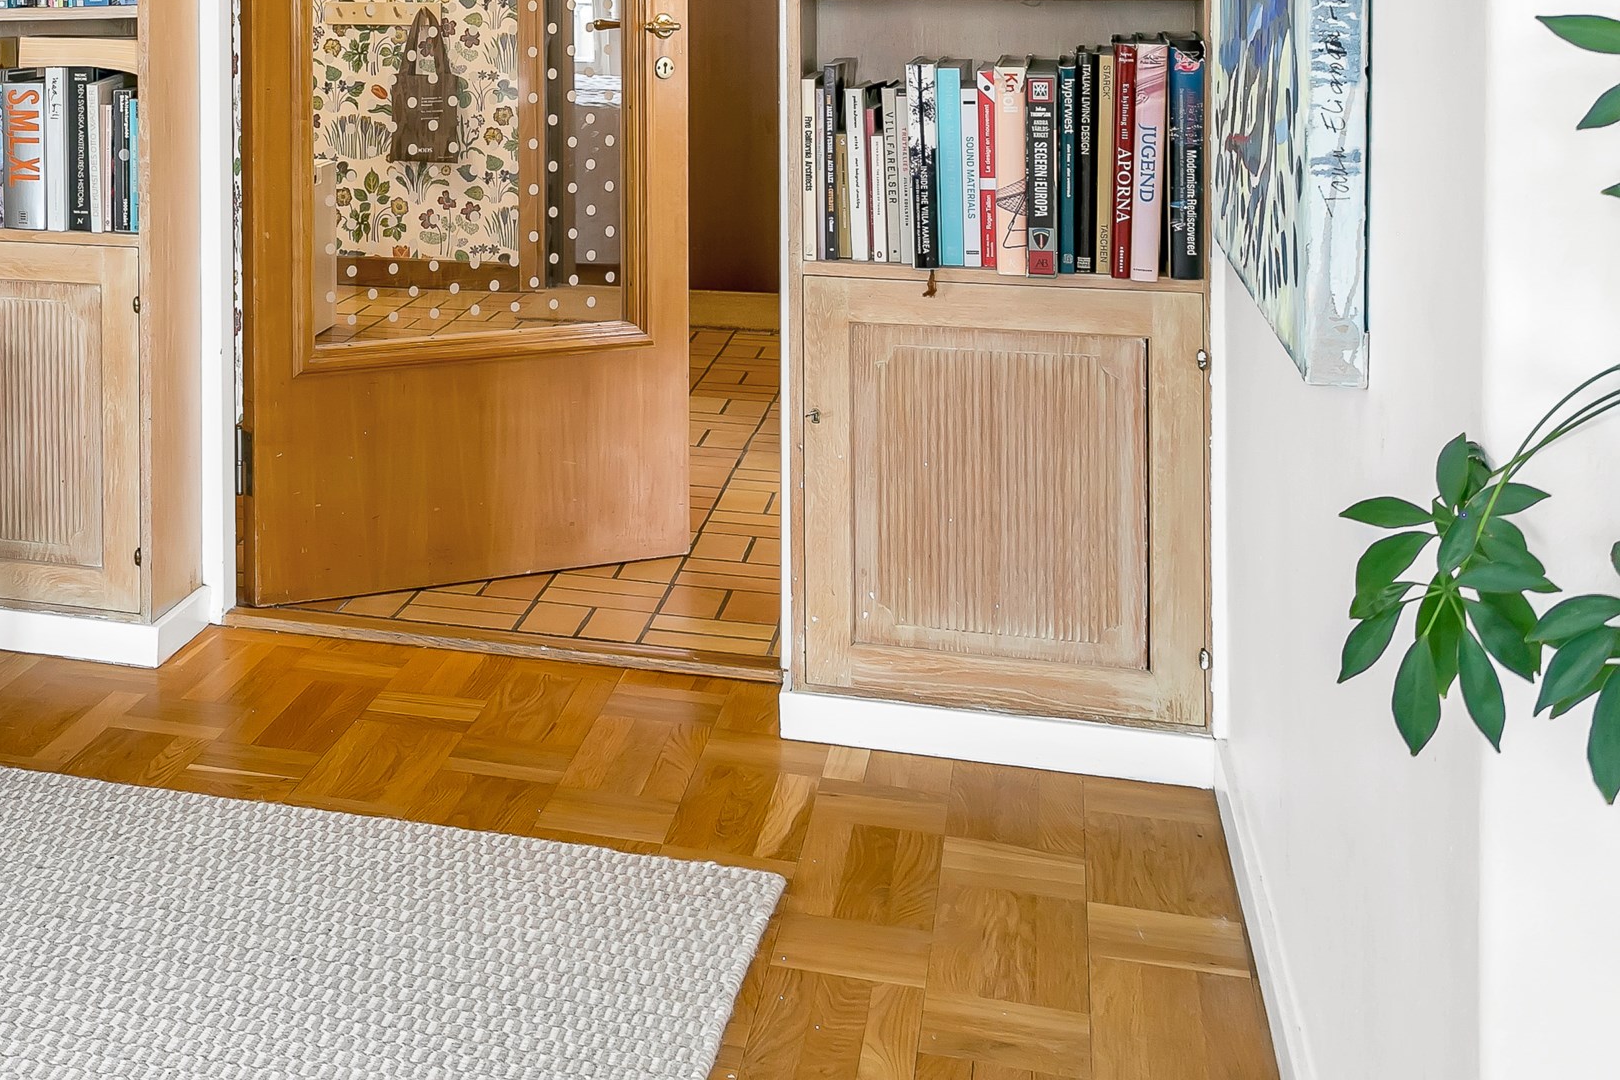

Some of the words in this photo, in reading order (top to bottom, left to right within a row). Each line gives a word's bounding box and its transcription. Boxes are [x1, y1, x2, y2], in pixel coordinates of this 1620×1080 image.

[1003, 73, 1019, 113] Knoll
[1082, 64, 1091, 94] ITALIAN
[804, 116, 813, 128] Five
[1061, 78, 1074, 134] hyperwest
[1081, 97, 1091, 124] LIVING
[804, 130, 813, 158] California
[885, 112, 897, 204] VILLFARELSER
[966, 136, 974, 167] SOUND
[1081, 126, 1090, 155] DESIGN
[805, 161, 813, 191] Architects
[1034, 142, 1047, 177] SEGERN
[1139, 124, 1156, 202] JUGEND
[966, 169, 975, 219] MATERIALS
[1034, 181, 1047, 217] EUROPA
[1116, 147, 1131, 223] APORNA
[1100, 225, 1108, 263] TASCHEN
